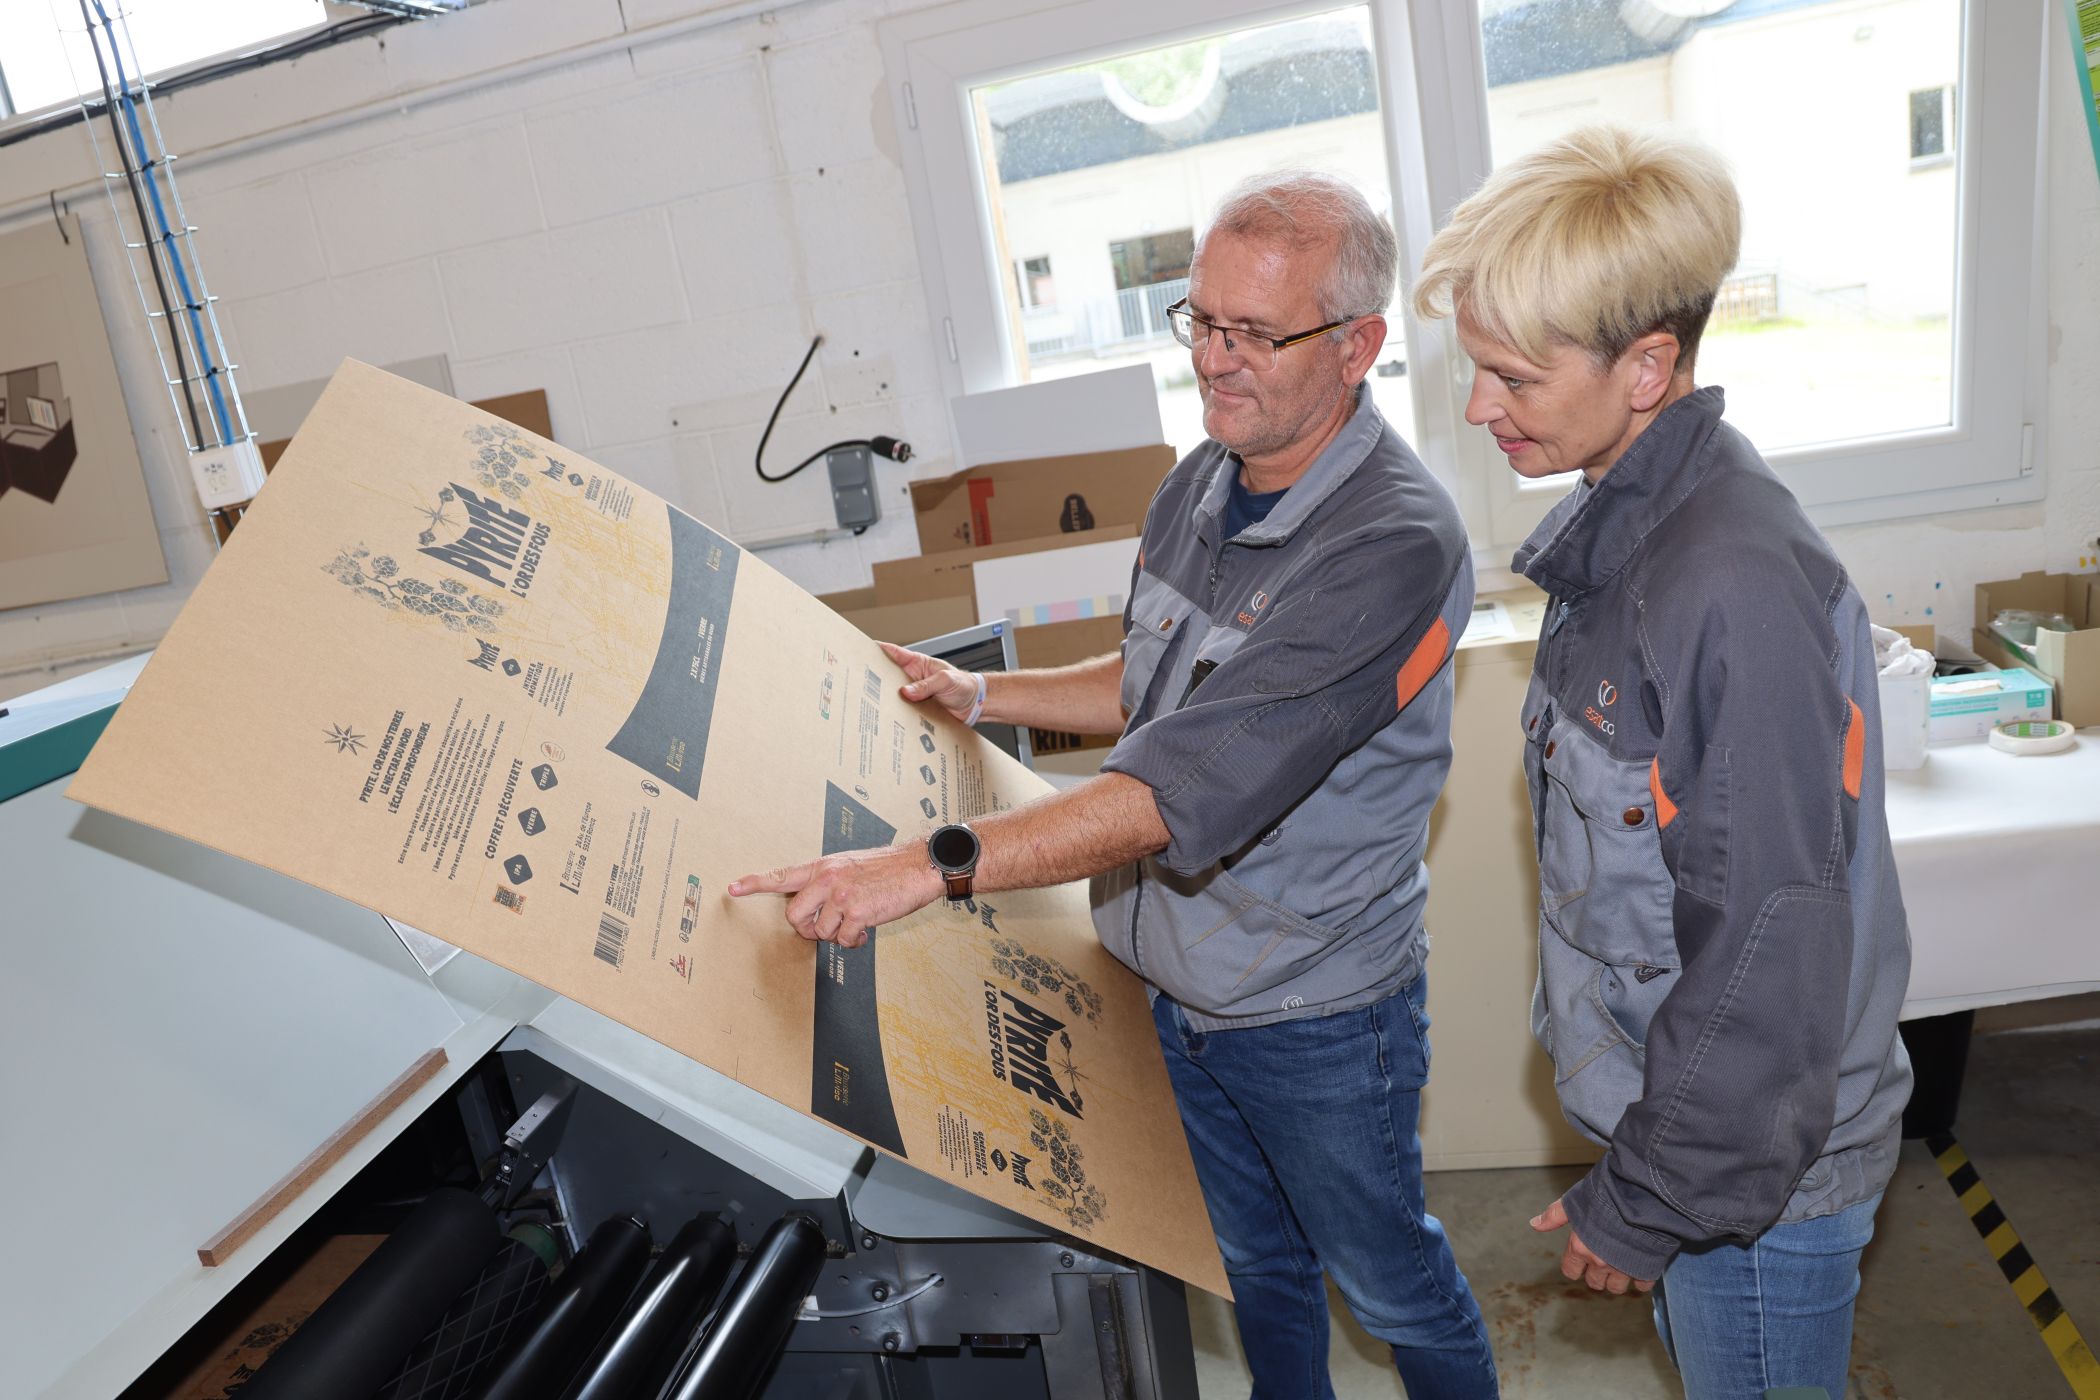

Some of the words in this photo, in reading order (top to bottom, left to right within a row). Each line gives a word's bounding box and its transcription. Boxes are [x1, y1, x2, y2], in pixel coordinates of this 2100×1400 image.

[540, 456, 566, 481] PYRITE
[417, 482, 530, 588] PYRITE
[467, 638, 500, 672] PYRITE
[523, 667, 534, 690] INTENSE
[528, 662, 544, 698] AROMATIQUE
[377, 749, 388, 760] DE
[381, 735, 394, 750] NOS
[394, 747, 404, 759] DU
[383, 758, 401, 786] NECTAR
[399, 772, 411, 786] DES
[540, 767, 550, 786] TRIPLE
[380, 785, 390, 795] LE
[485, 817, 504, 859] COFFRET
[498, 759, 523, 817] DÉCOUVERTE
[527, 810, 537, 829] VERRE
[514, 865, 522, 875] IPA
[611, 864, 619, 881] VERRE
[981, 901, 999, 934] PYRITE
[1000, 990, 1084, 1120] PYRITE
[973, 1132, 982, 1171] ÉQUILIBRÉE
[978, 1132, 987, 1170] GÉNÉREUSE
[1011, 1151, 1036, 1191] PYRITE
